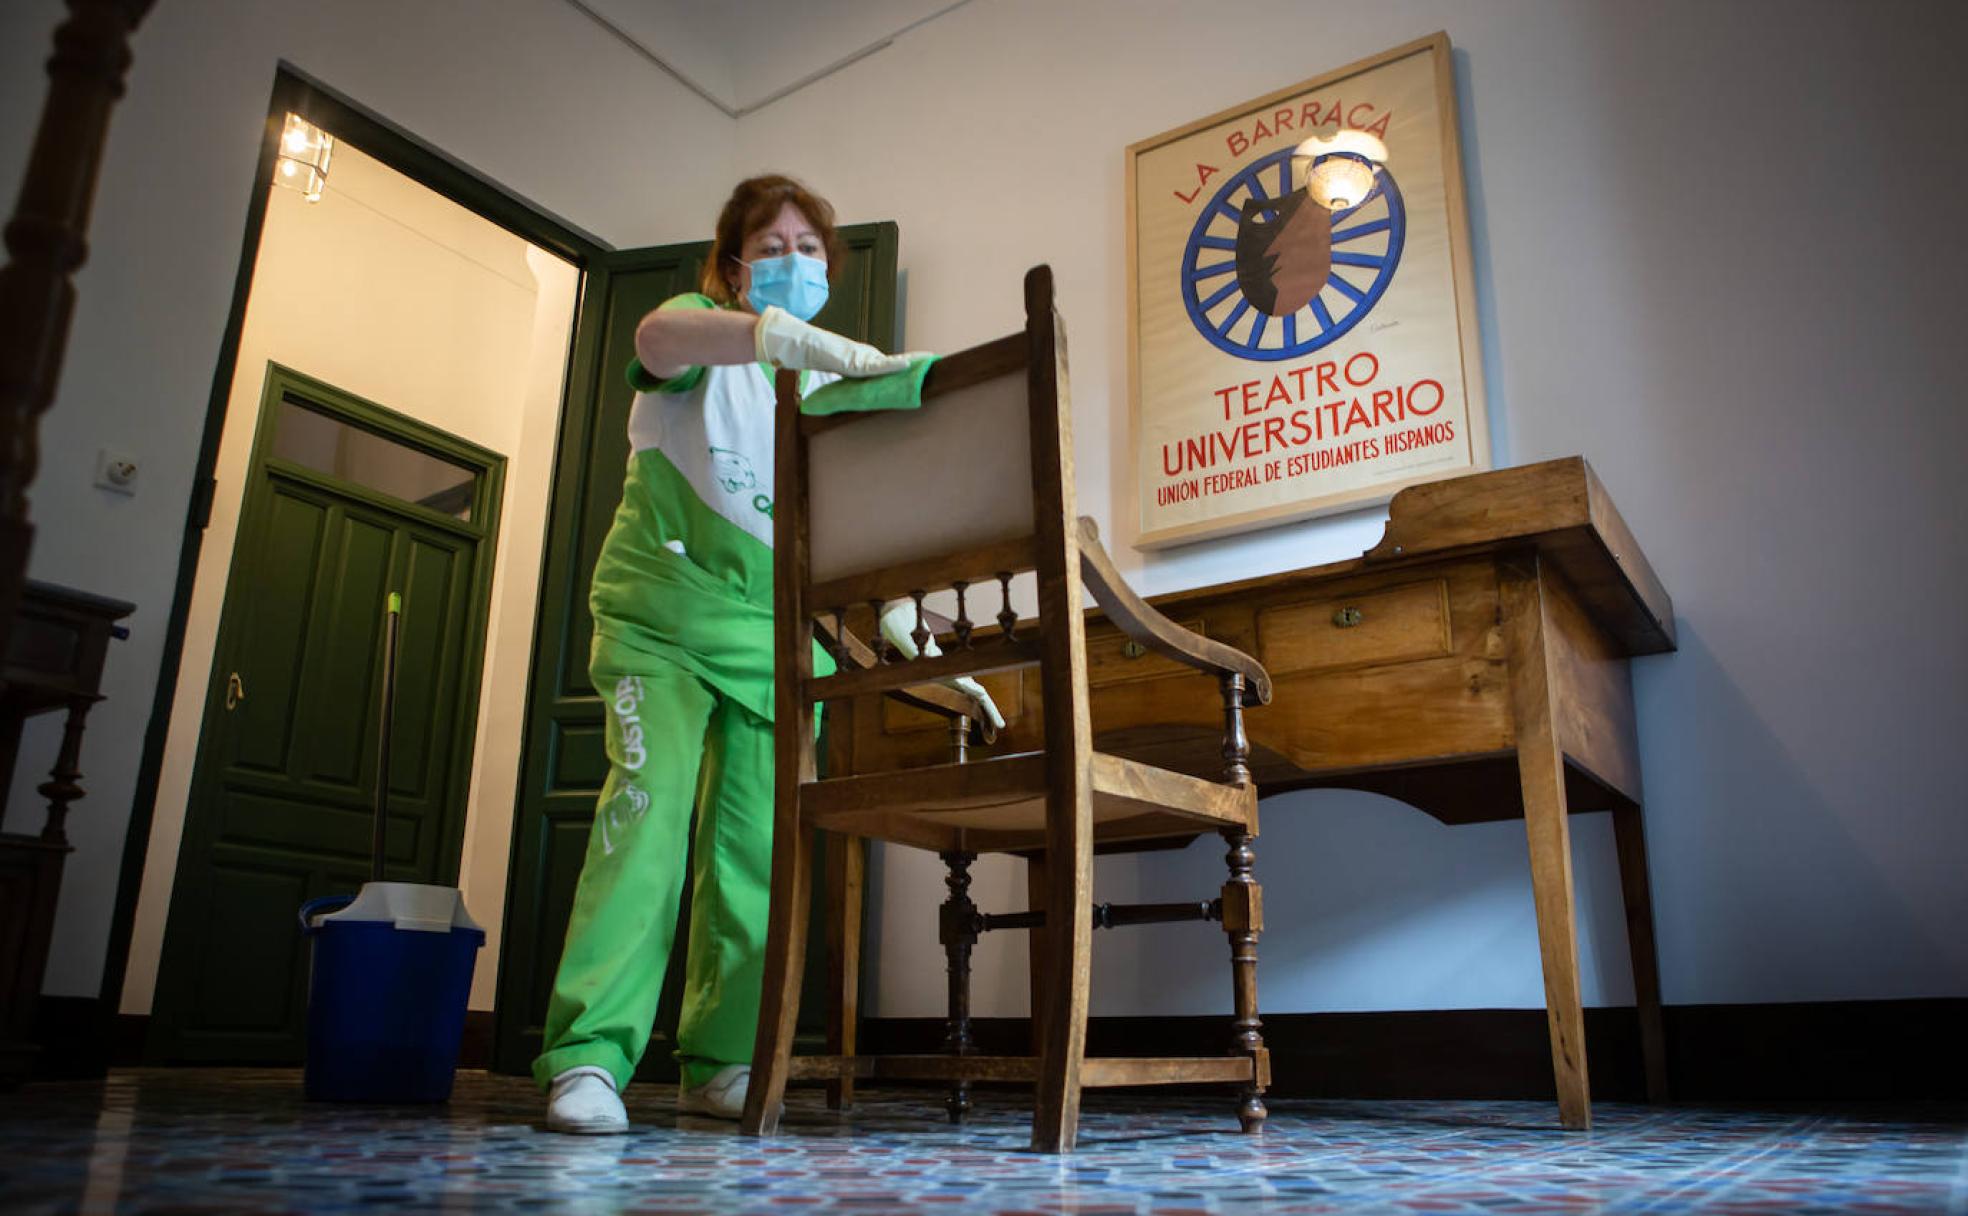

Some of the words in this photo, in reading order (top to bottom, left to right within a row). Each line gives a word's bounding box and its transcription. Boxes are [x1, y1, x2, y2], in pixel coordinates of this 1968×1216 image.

[1173, 163, 1219, 204] LA
[1226, 100, 1392, 158] BARRACA
[1162, 378, 1446, 477] UNIVERSITARIO
[1214, 351, 1380, 421] TEATRO
[1203, 466, 1259, 497] FEDERAL
[1264, 460, 1282, 482] DE
[1287, 437, 1381, 478] ESTUDIANTES
[1384, 419, 1456, 456] HISPANOS
